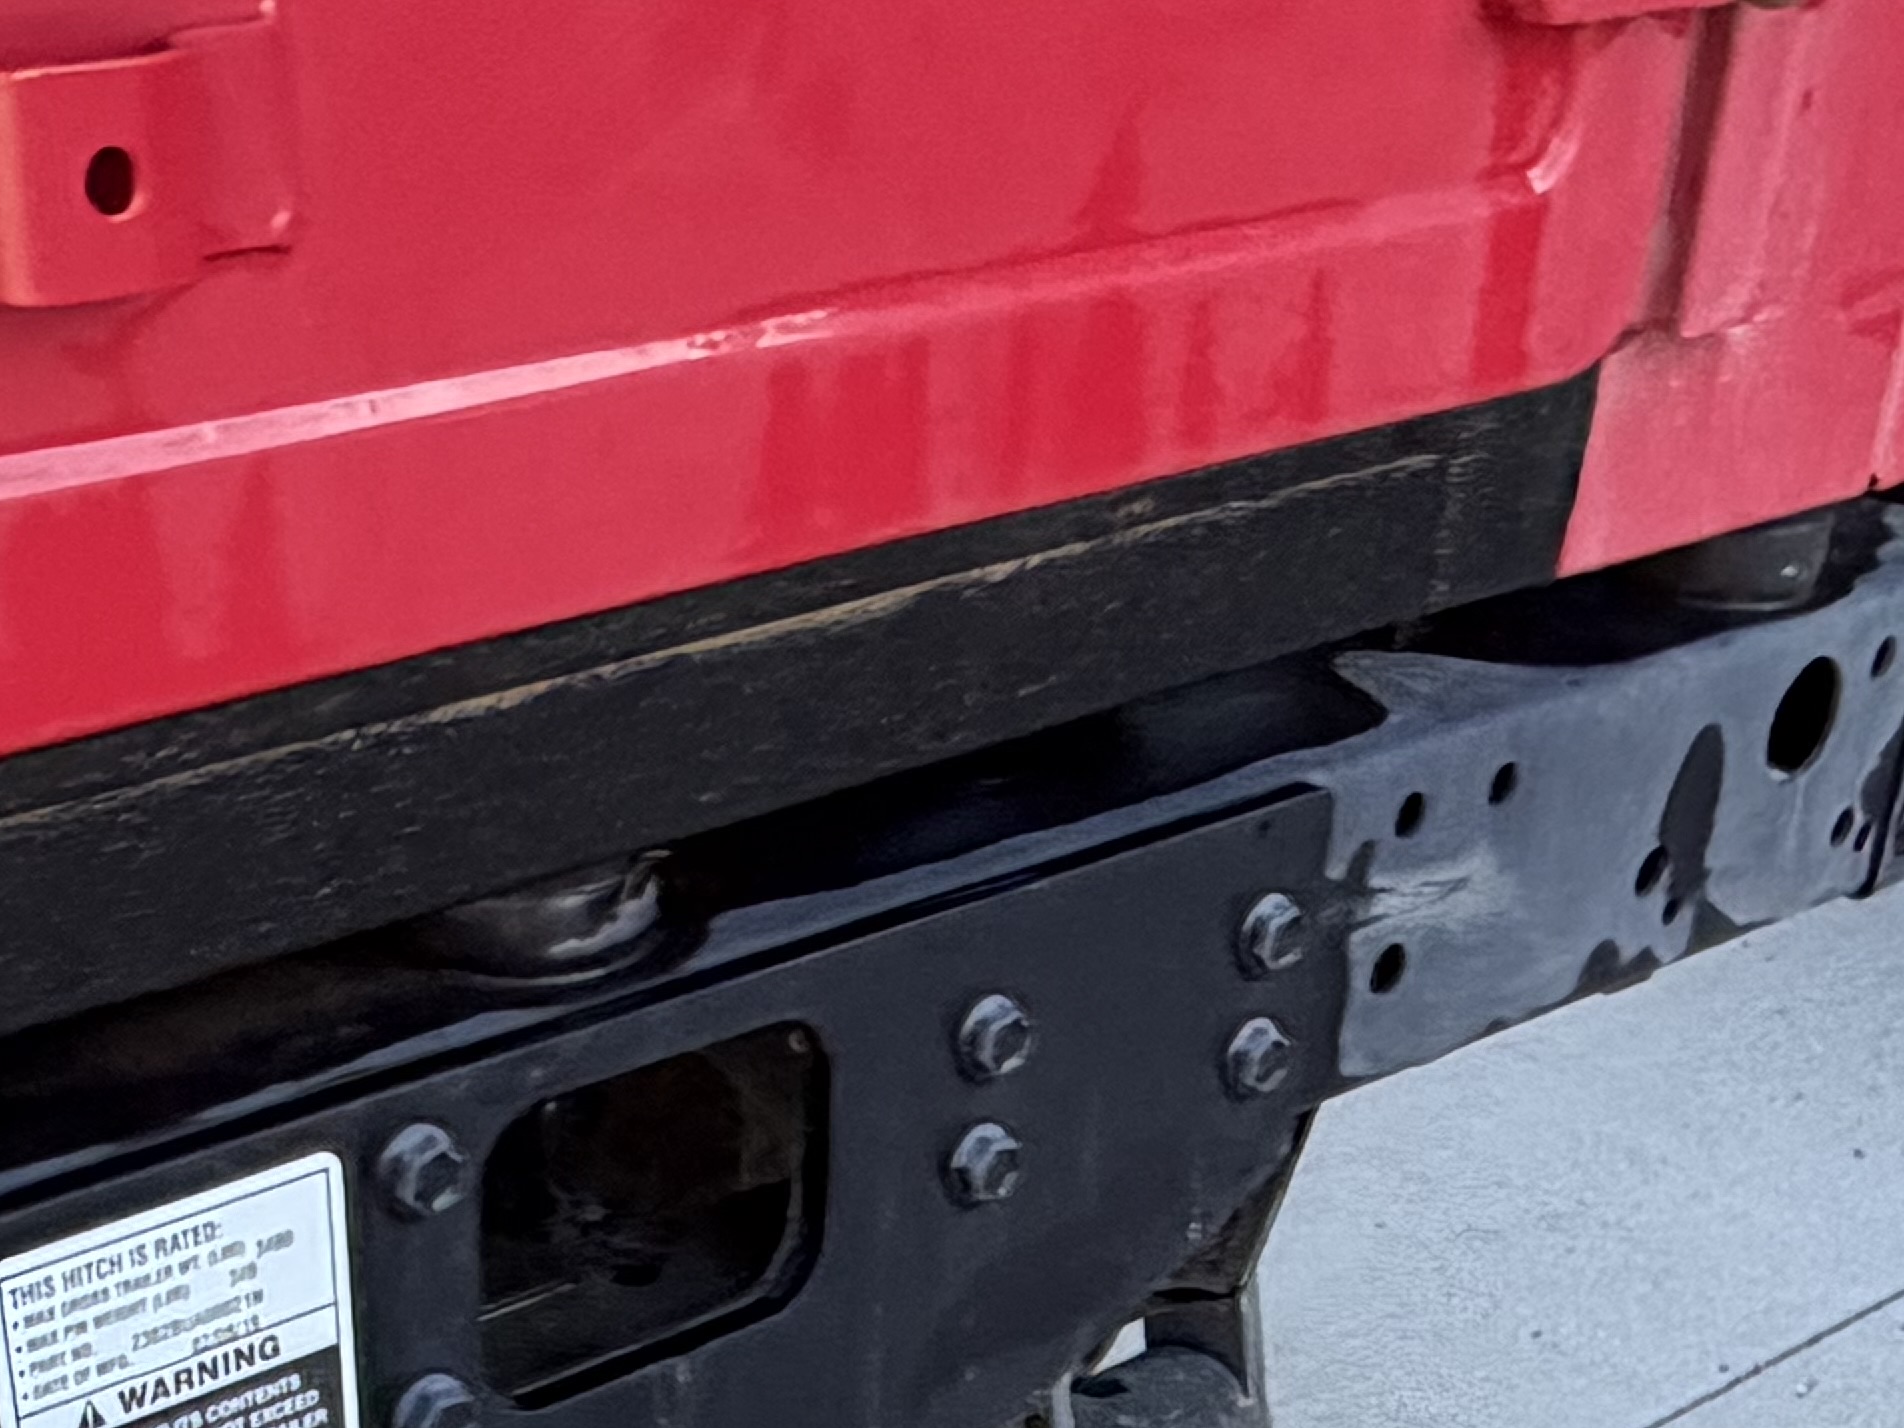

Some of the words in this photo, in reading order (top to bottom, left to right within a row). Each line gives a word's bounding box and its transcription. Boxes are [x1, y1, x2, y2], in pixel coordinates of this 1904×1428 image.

[8, 1275, 55, 1309] THIS
[61, 1253, 123, 1291] HITCH
[129, 1243, 147, 1267] IS
[154, 1221, 221, 1259] RATED:
[118, 1334, 280, 1414] WARNING
[205, 1374, 301, 1423] CONTENTS
[249, 1389, 319, 1428] EXCEED
